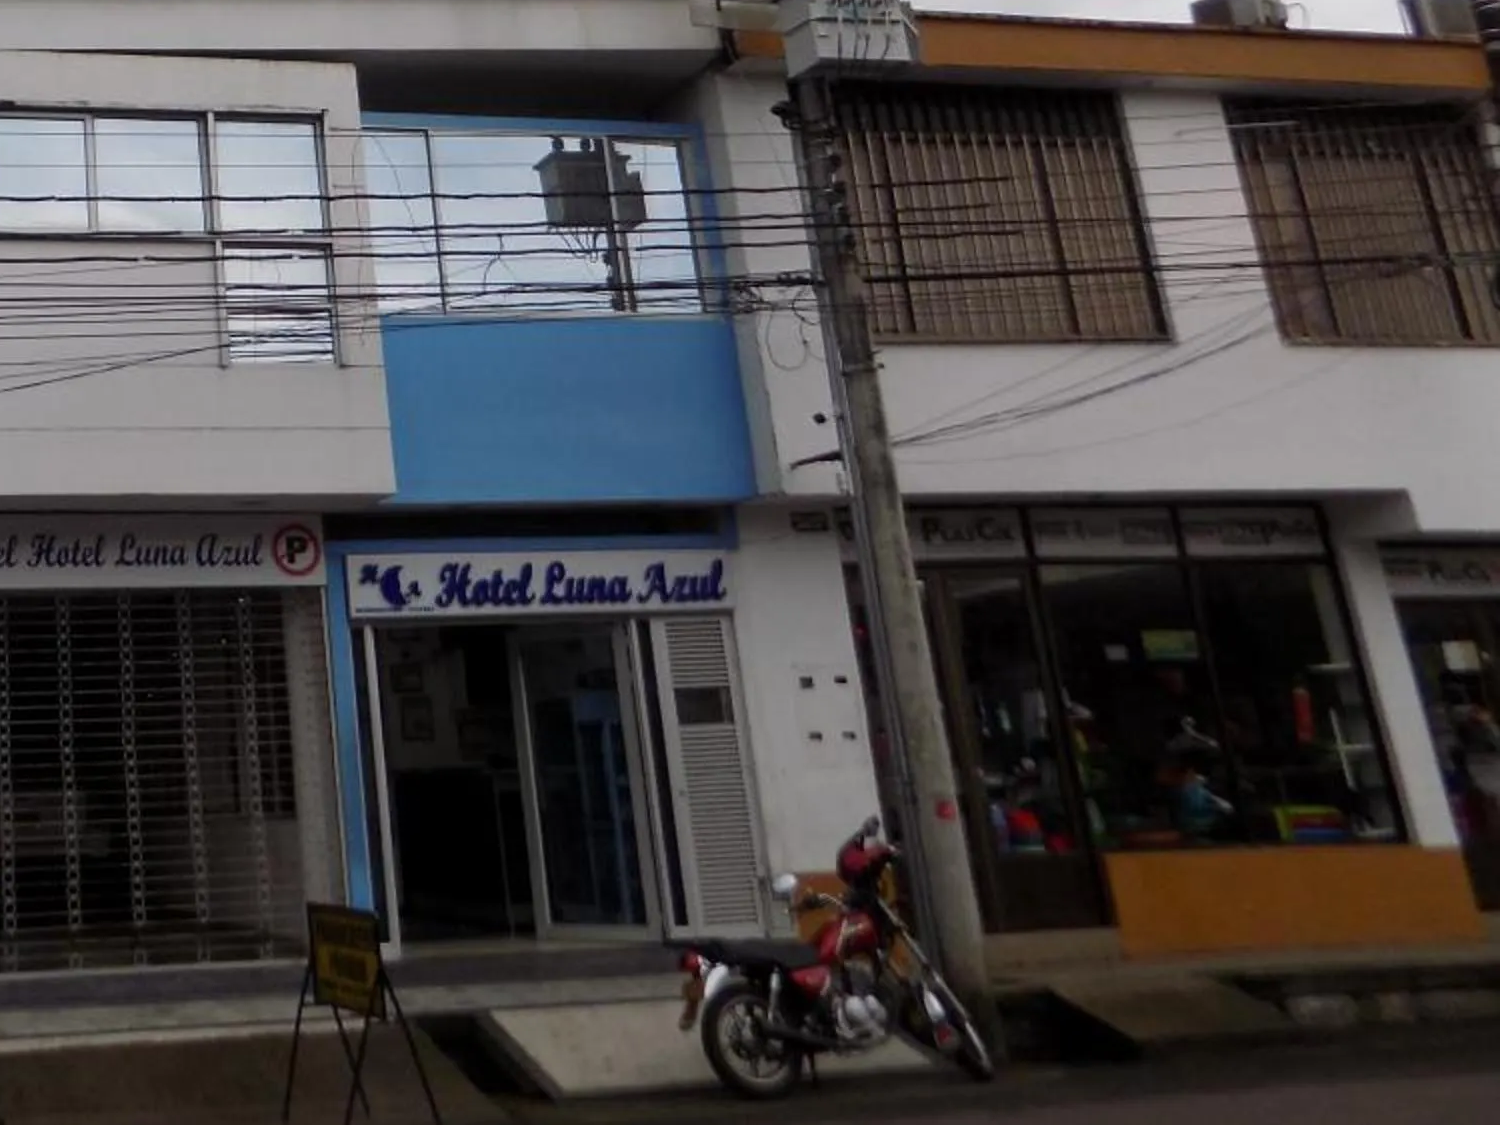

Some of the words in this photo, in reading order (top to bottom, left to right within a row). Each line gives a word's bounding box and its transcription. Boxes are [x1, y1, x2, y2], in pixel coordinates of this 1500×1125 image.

[26, 532, 106, 569] Hotel
[115, 531, 187, 567] Luna
[196, 534, 266, 567] Azul
[434, 562, 536, 609] Hotel
[540, 560, 633, 606] Luna
[637, 558, 727, 605] Azul
